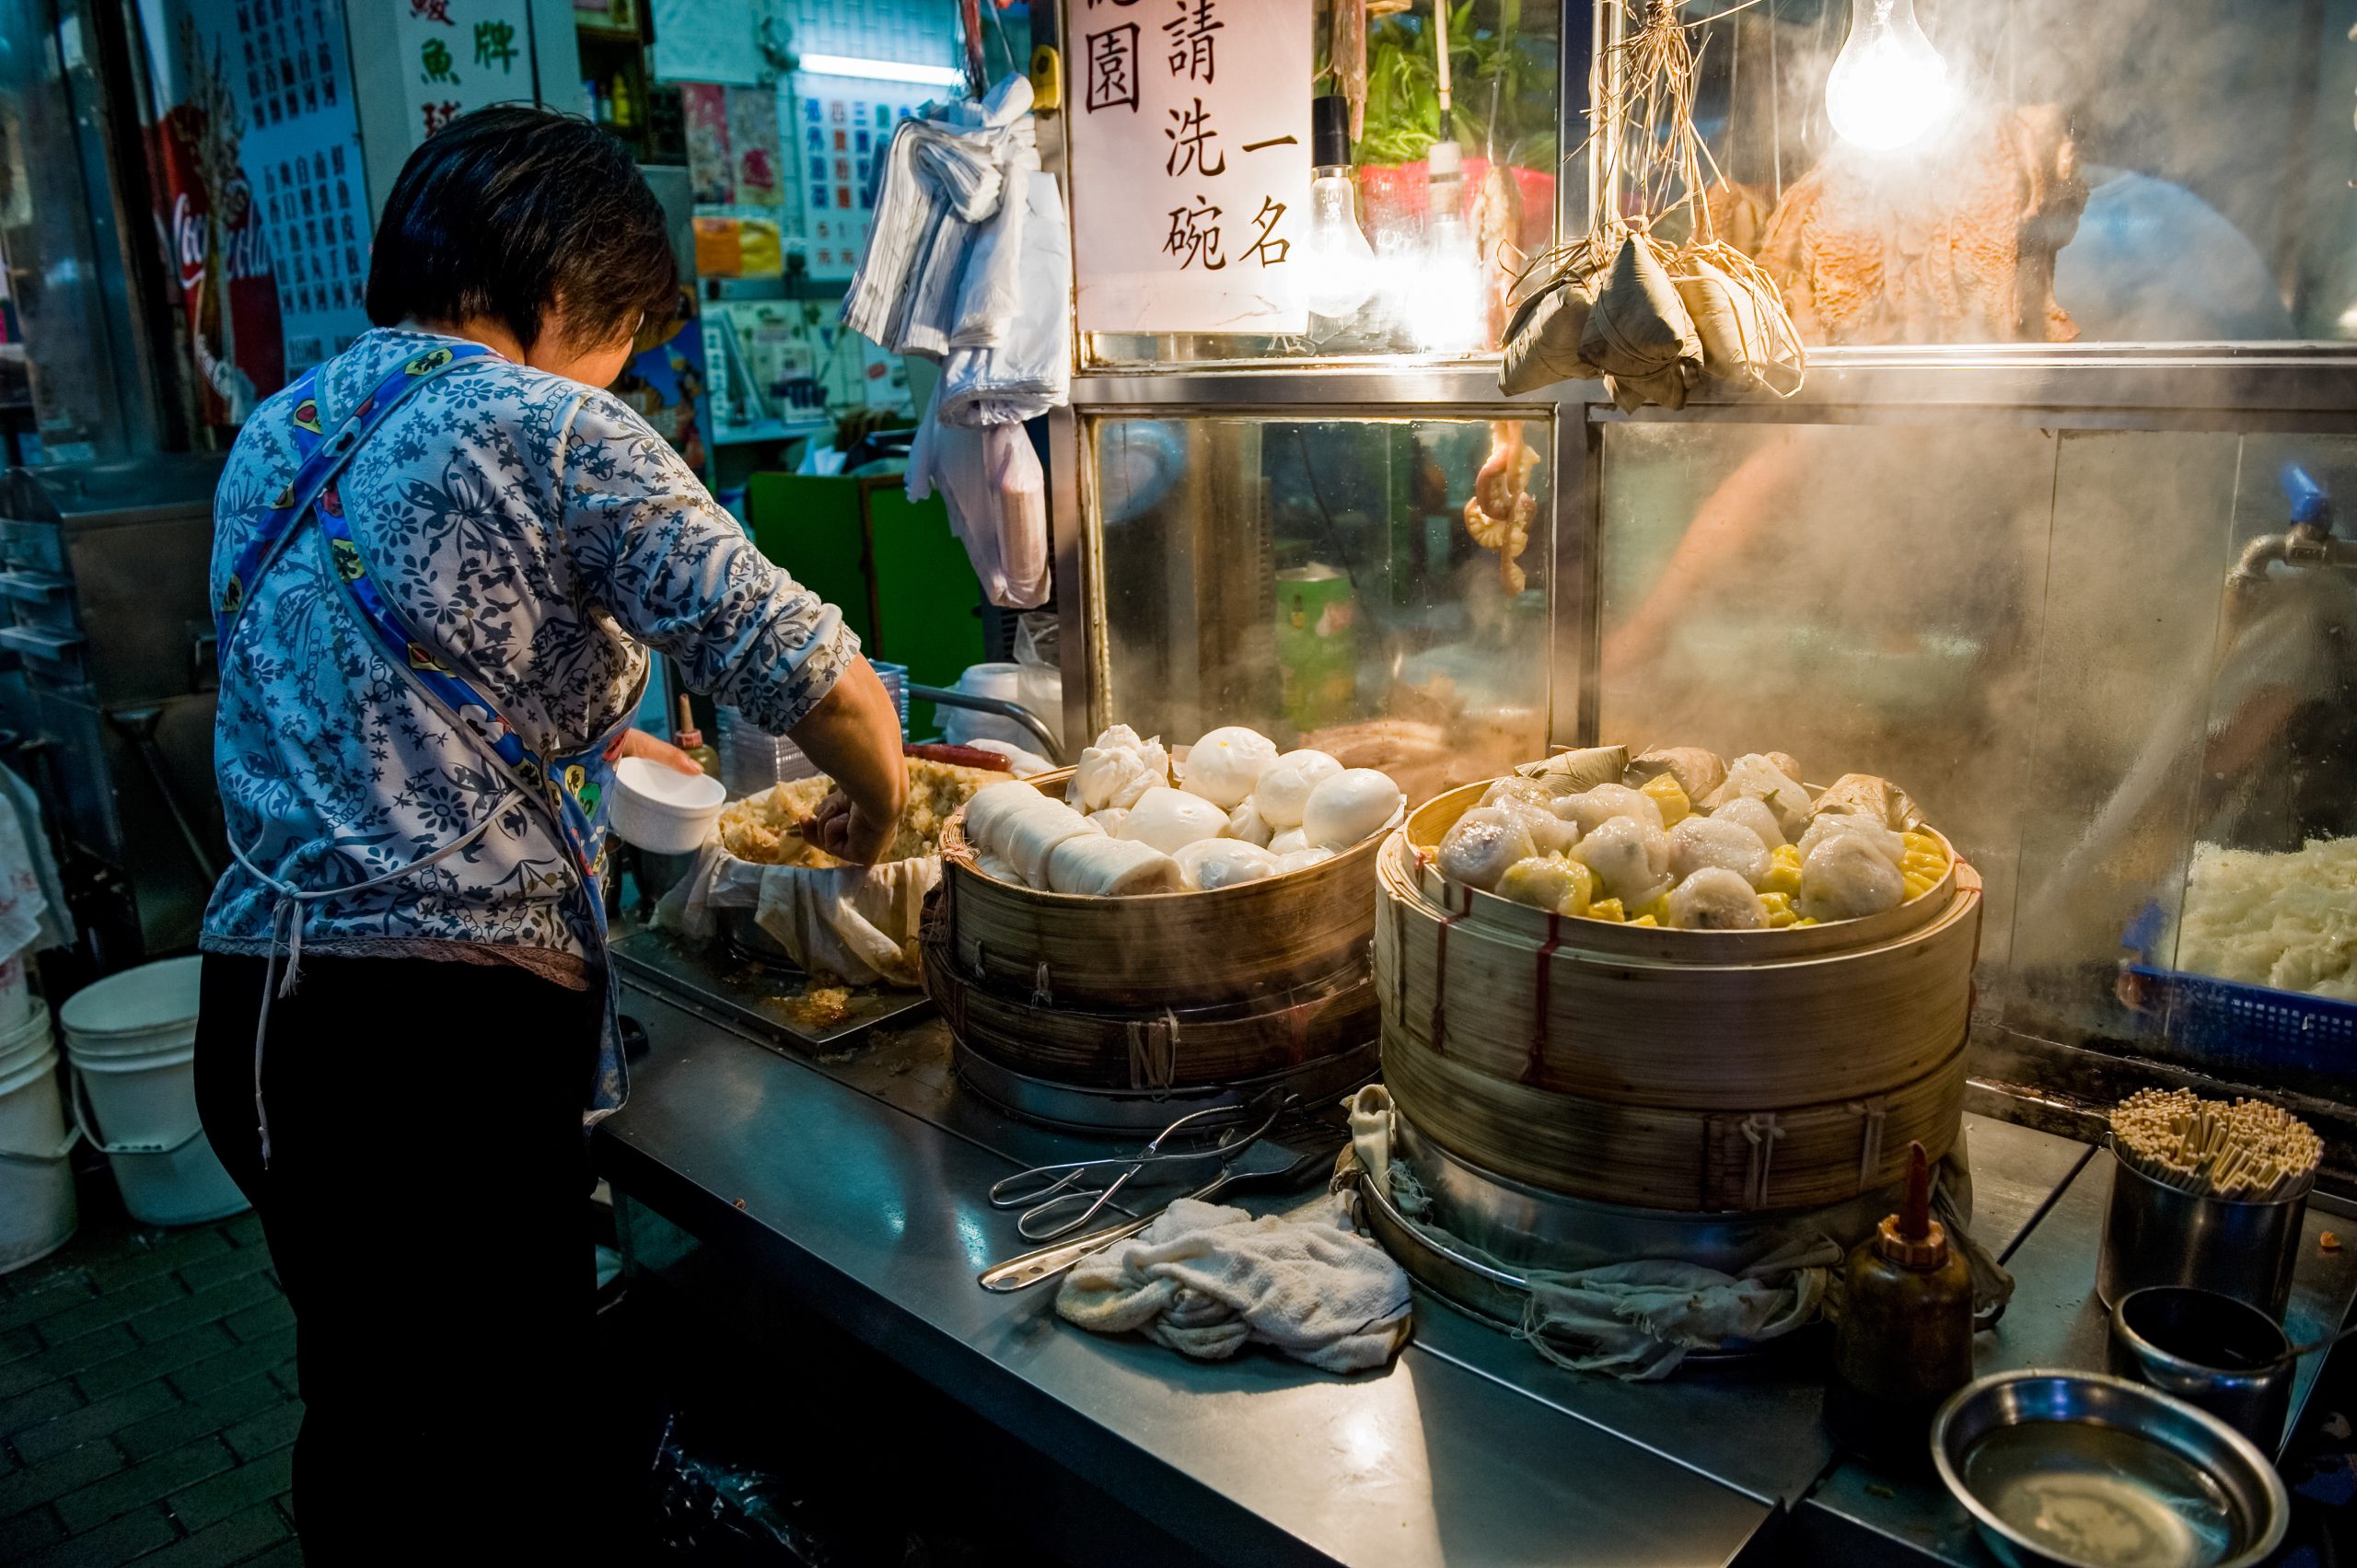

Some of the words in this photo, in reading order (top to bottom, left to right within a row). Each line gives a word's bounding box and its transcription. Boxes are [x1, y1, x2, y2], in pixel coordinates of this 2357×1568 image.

[473, 19, 519, 75] 牌
[1086, 0, 1142, 115] 園
[1161, 0, 1227, 273] 請洗碗
[1238, 133, 1300, 271] 一名
